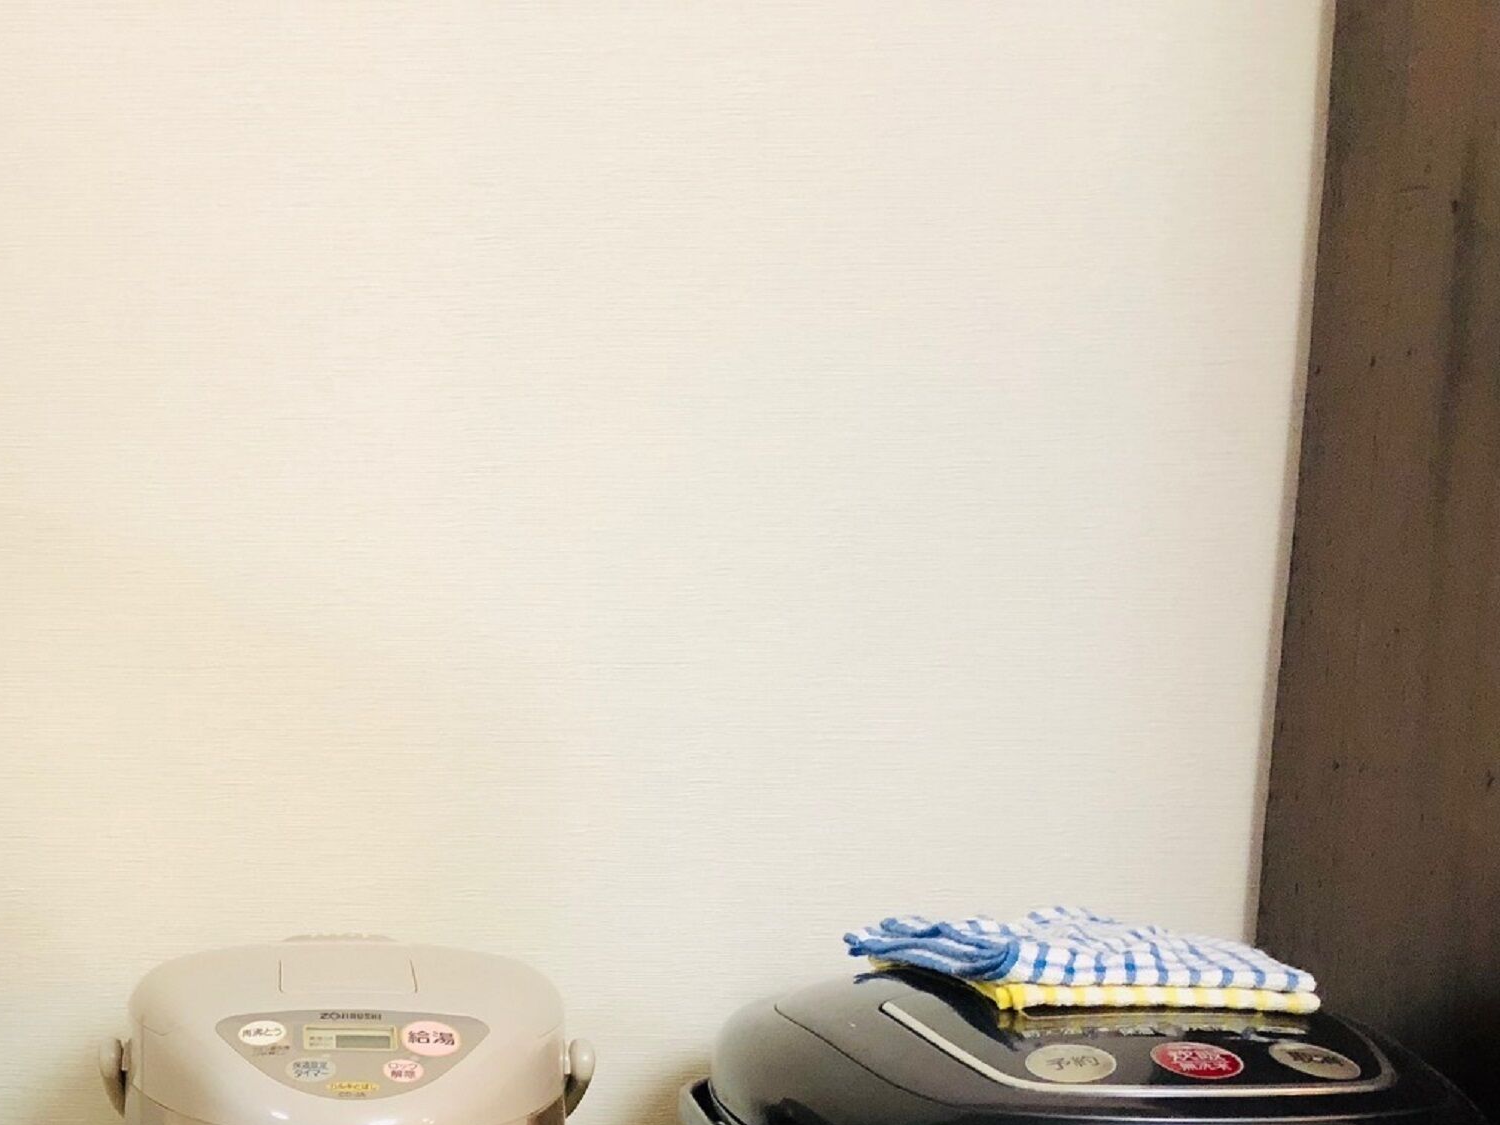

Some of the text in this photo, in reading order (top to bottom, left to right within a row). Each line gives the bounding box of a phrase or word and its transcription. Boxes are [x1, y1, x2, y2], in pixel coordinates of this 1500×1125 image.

[319, 1012, 382, 1021] ZOJIRUSHI
[408, 1031, 455, 1046] 給湯
[1046, 1055, 1100, 1071] 予約
